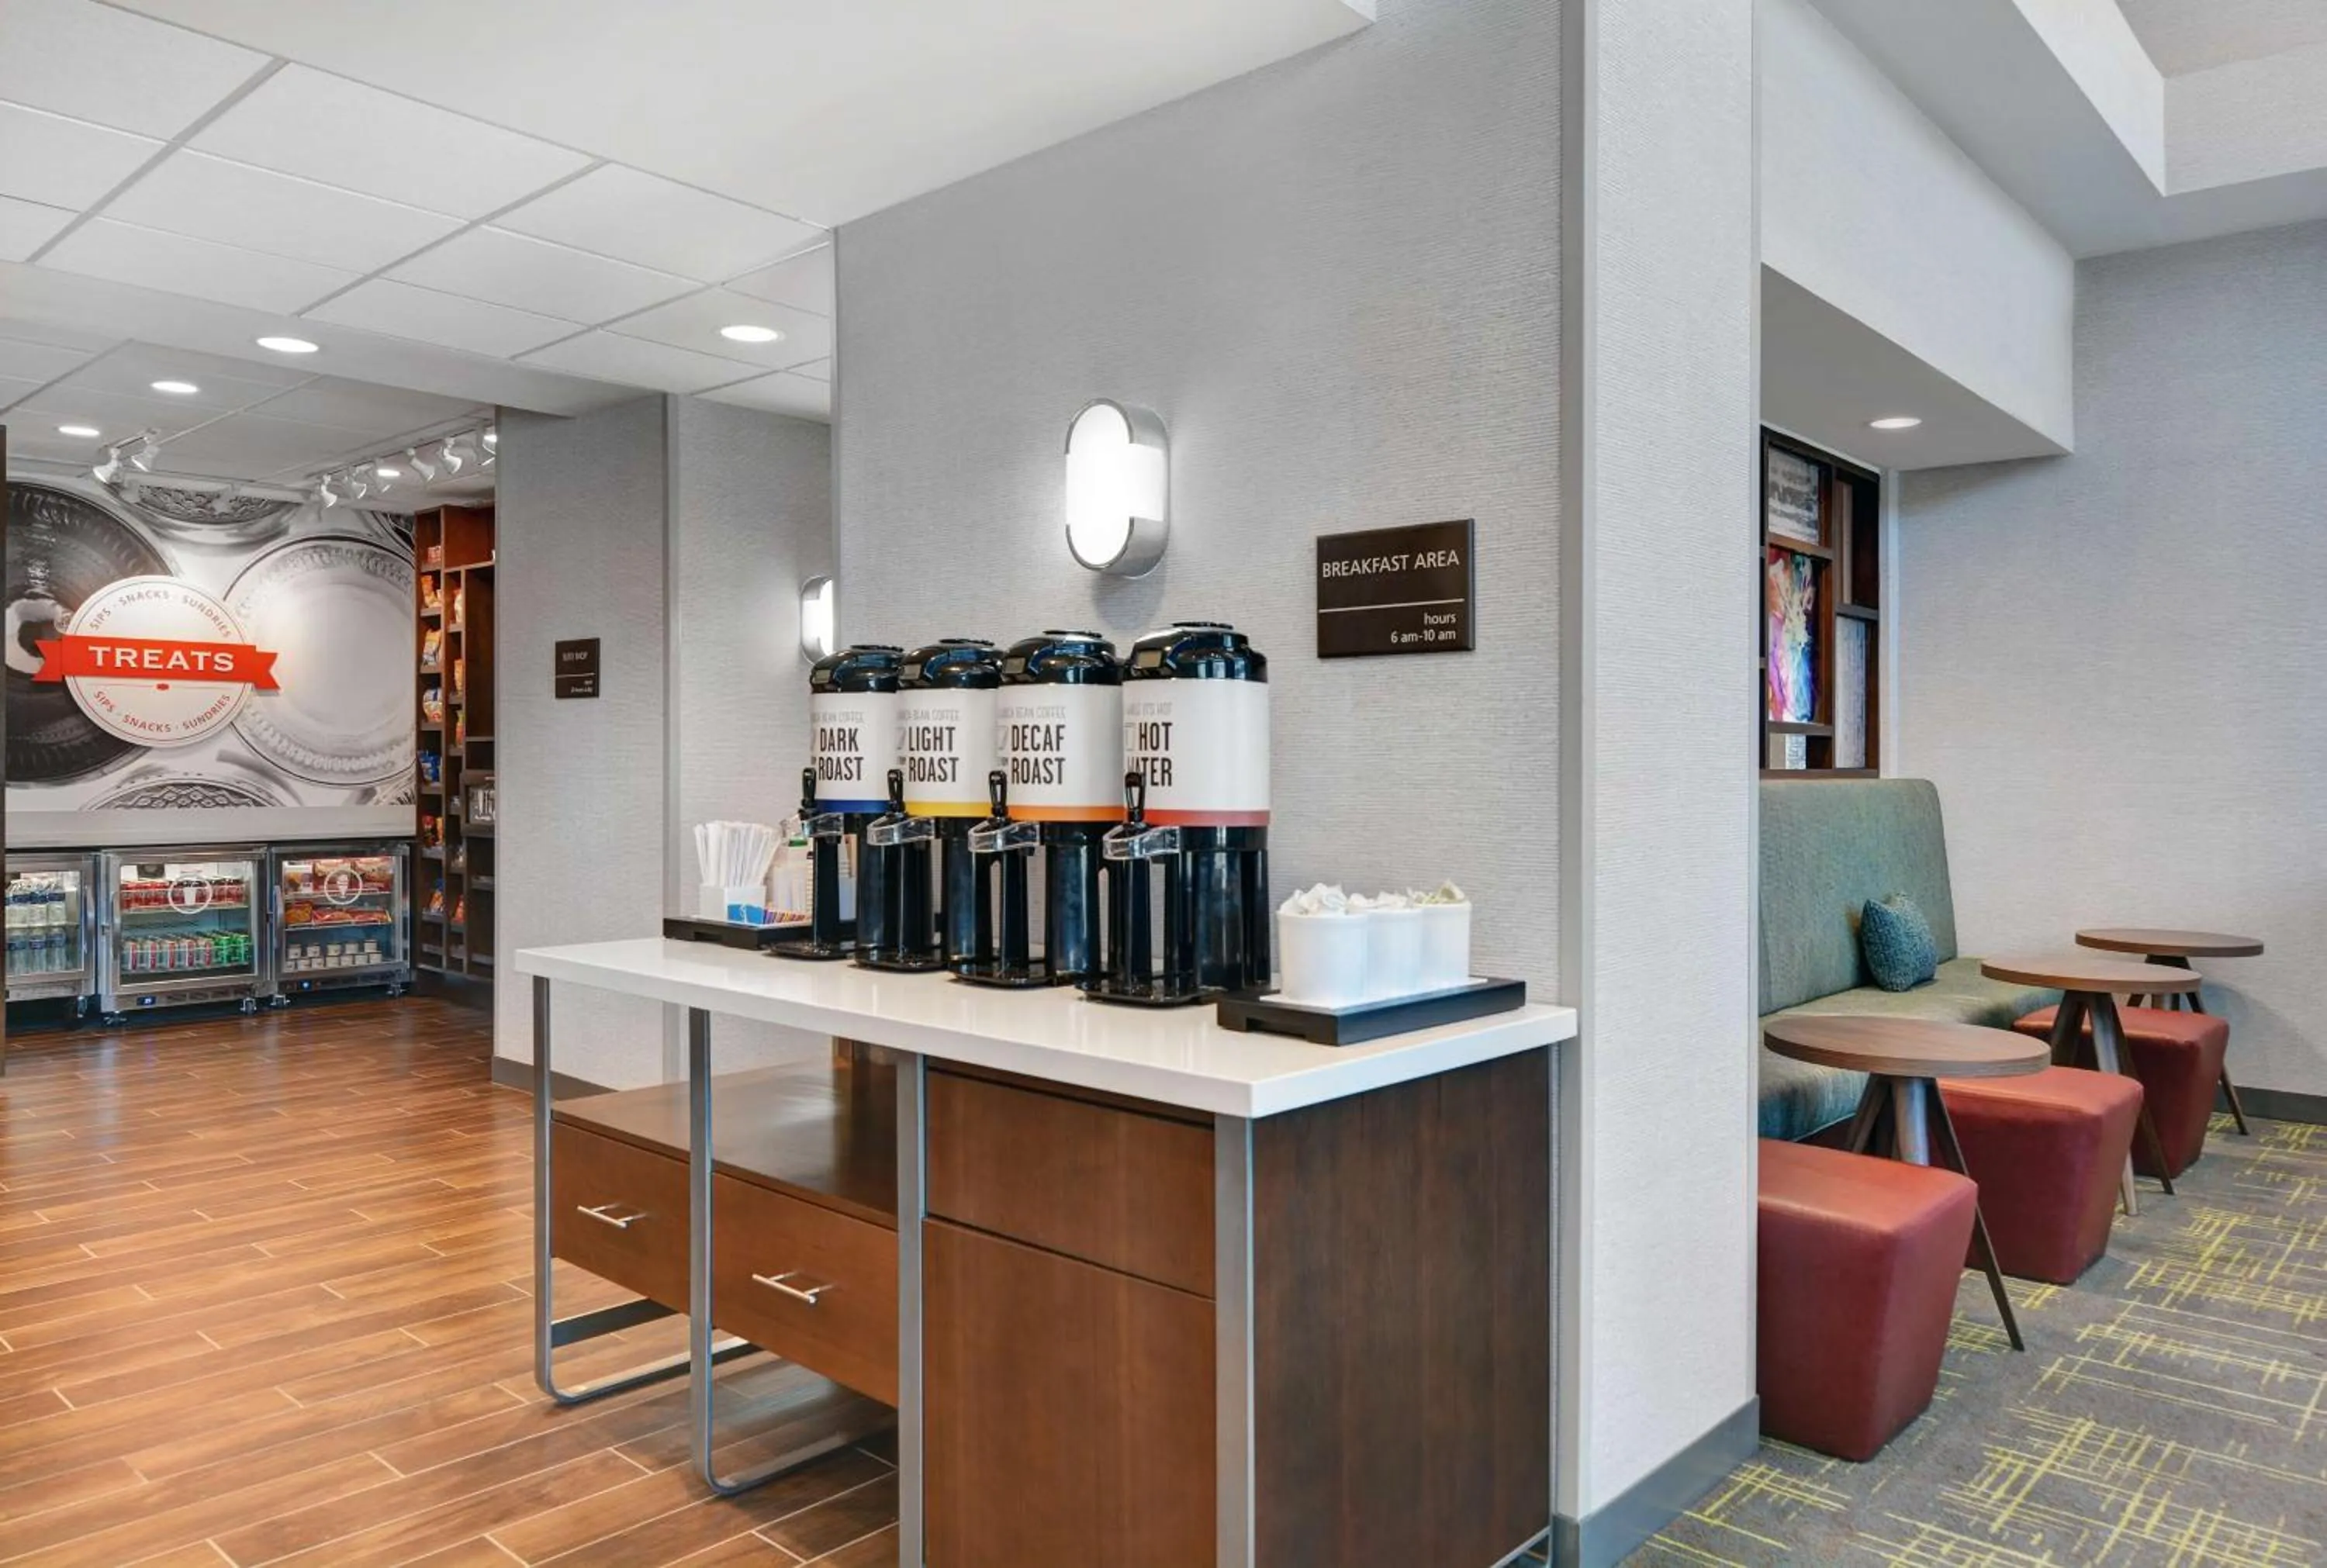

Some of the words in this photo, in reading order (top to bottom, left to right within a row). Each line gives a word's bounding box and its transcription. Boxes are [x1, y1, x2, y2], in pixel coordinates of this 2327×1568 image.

[1322, 554, 1410, 579] BREAKFAST
[1414, 549, 1460, 570] AREA
[89, 608, 112, 631] SIPS
[119, 589, 170, 606] SNACKS
[182, 594, 233, 638] SUNDRIES
[1423, 612, 1457, 626] hours
[1390, 630, 1399, 644] 6
[1400, 629, 1435, 643] am-10
[1437, 630, 1457, 641] am
[88, 644, 235, 673] TREATS
[93, 689, 116, 713] SIPS
[122, 713, 172, 734] SNACKS
[182, 693, 231, 730] SUNDRIES
[819, 727, 859, 752] DARK
[908, 726, 956, 752] LIGHT
[1011, 724, 1067, 752] DECAF
[1139, 721, 1174, 751] HOT
[818, 756, 864, 781] ROAST
[908, 757, 959, 783] ROAST
[1011, 757, 1067, 785] ROAST
